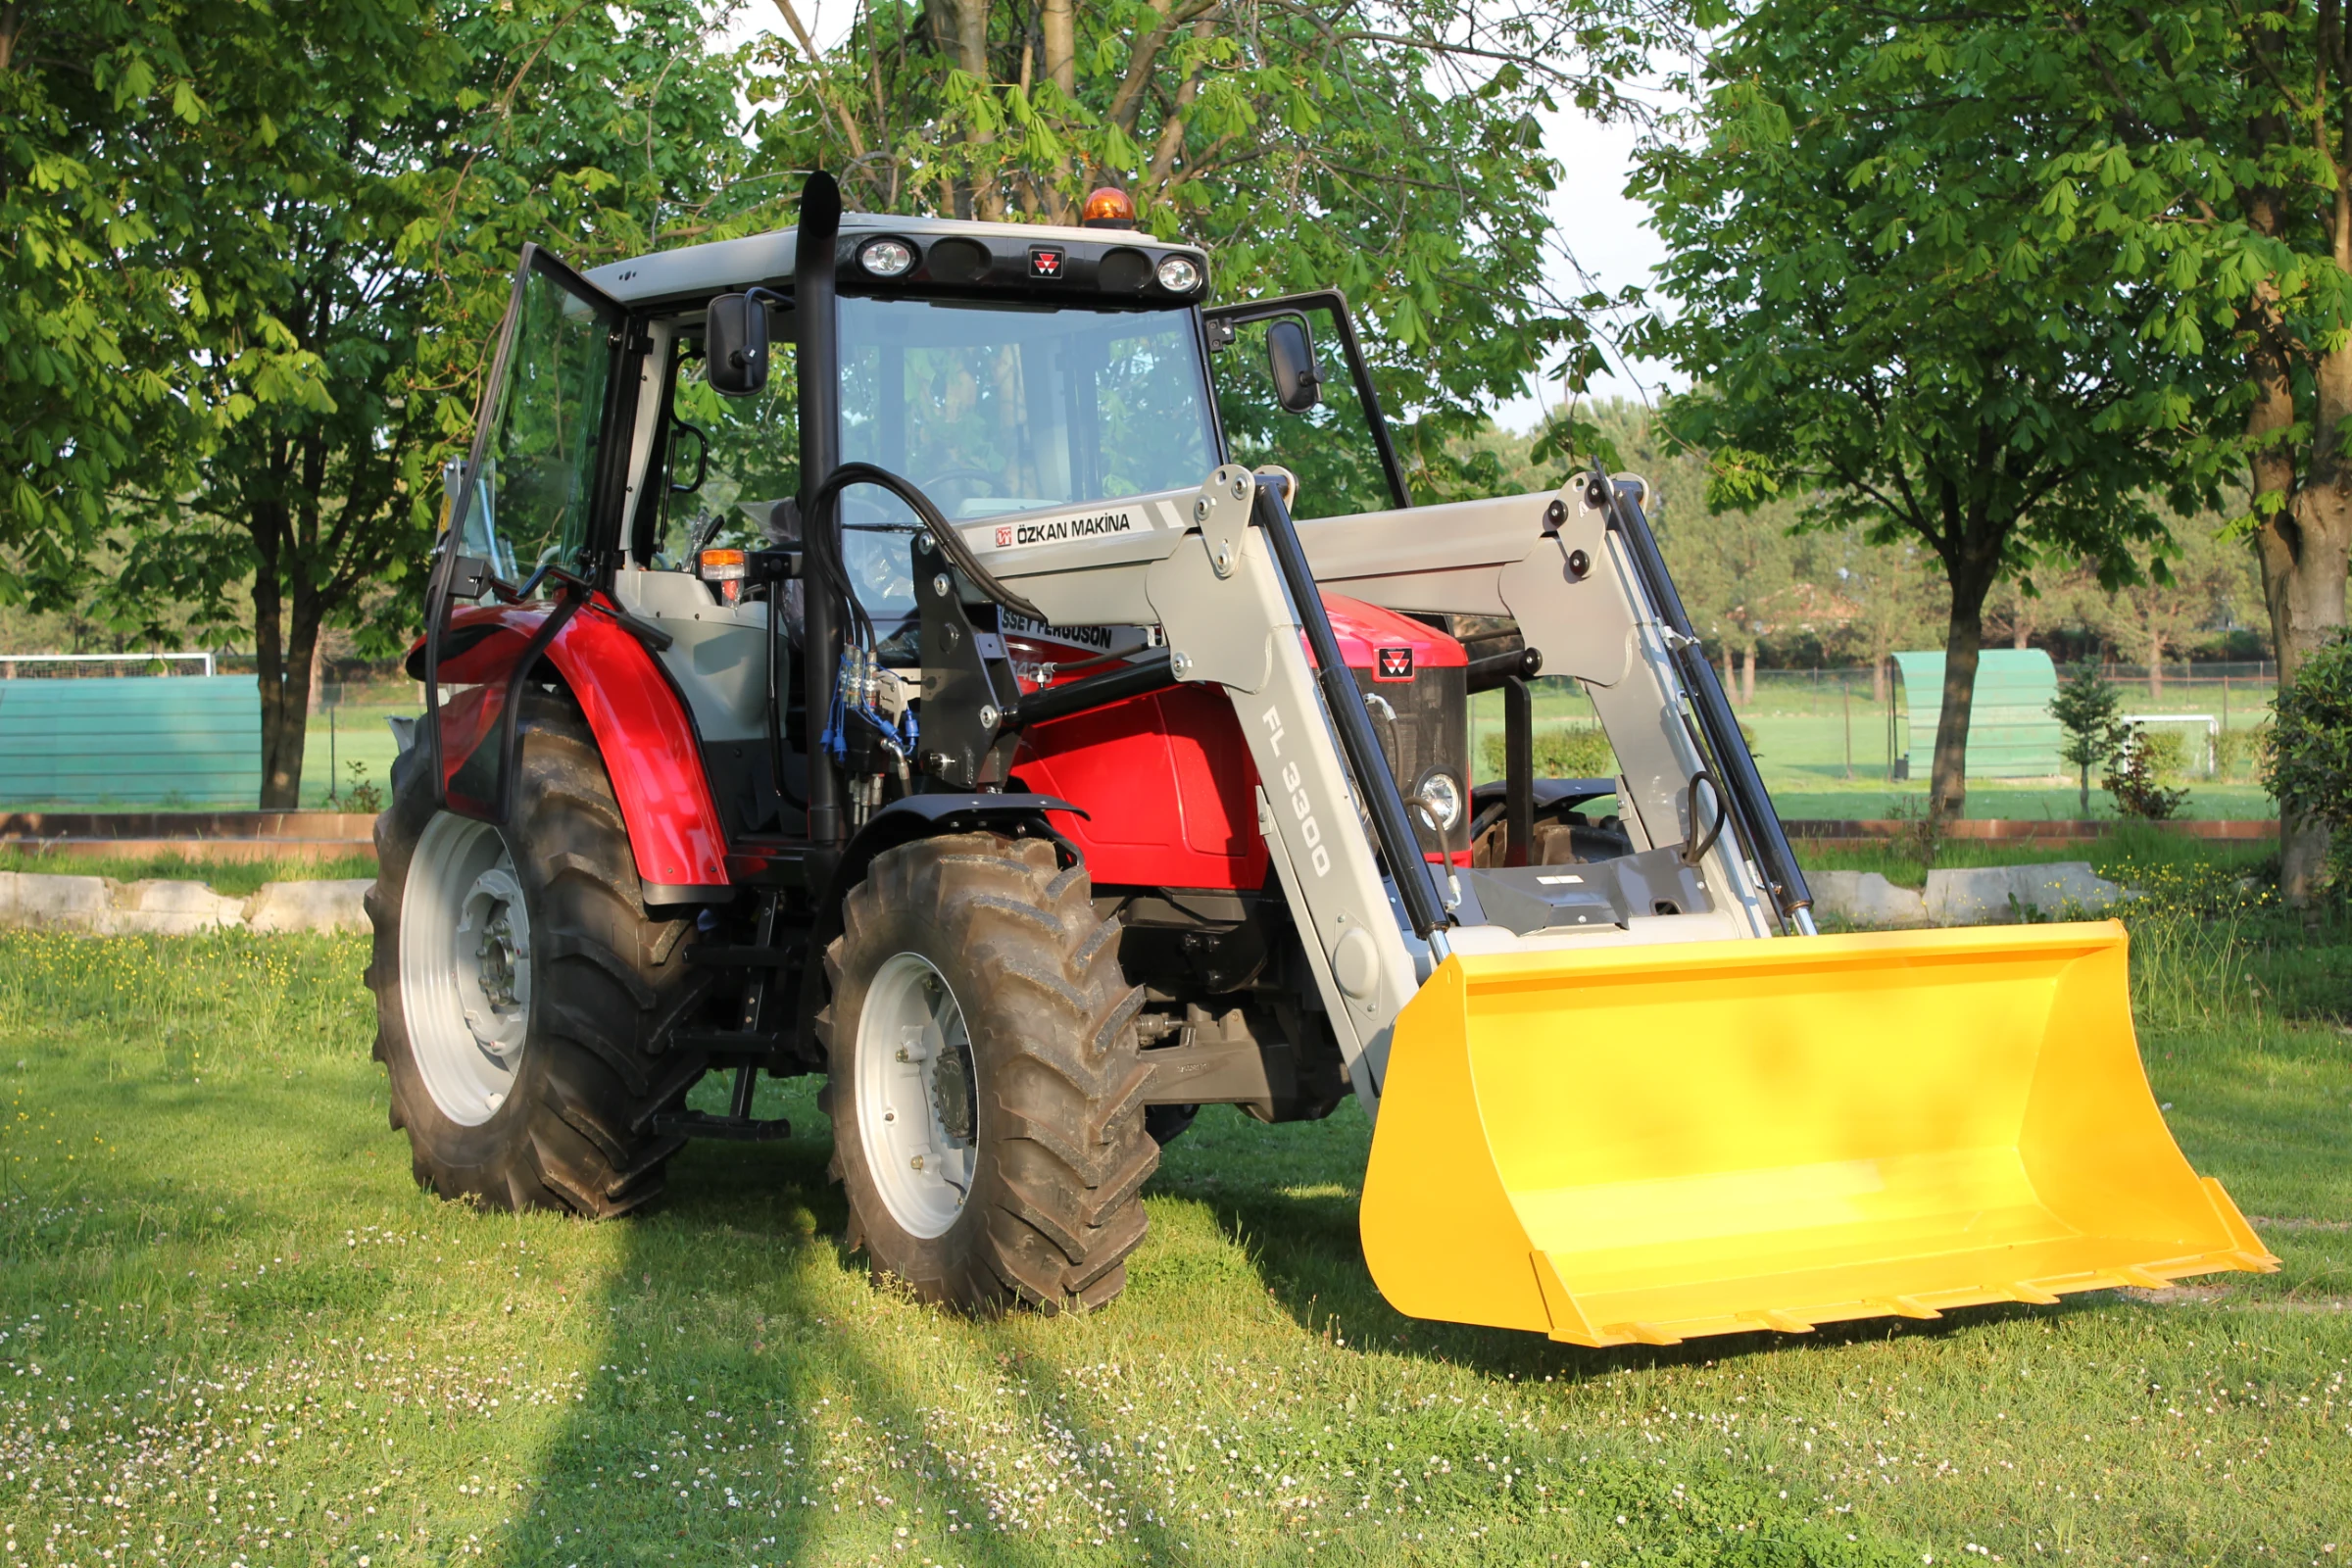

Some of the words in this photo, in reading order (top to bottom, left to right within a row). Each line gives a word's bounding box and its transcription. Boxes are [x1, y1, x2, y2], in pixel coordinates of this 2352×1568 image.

[1017, 522, 1067, 544] ÖZKAN
[1071, 513, 1130, 537] MAKİNA
[1262, 705, 1285, 758] FL
[1282, 760, 1331, 878] 3300
